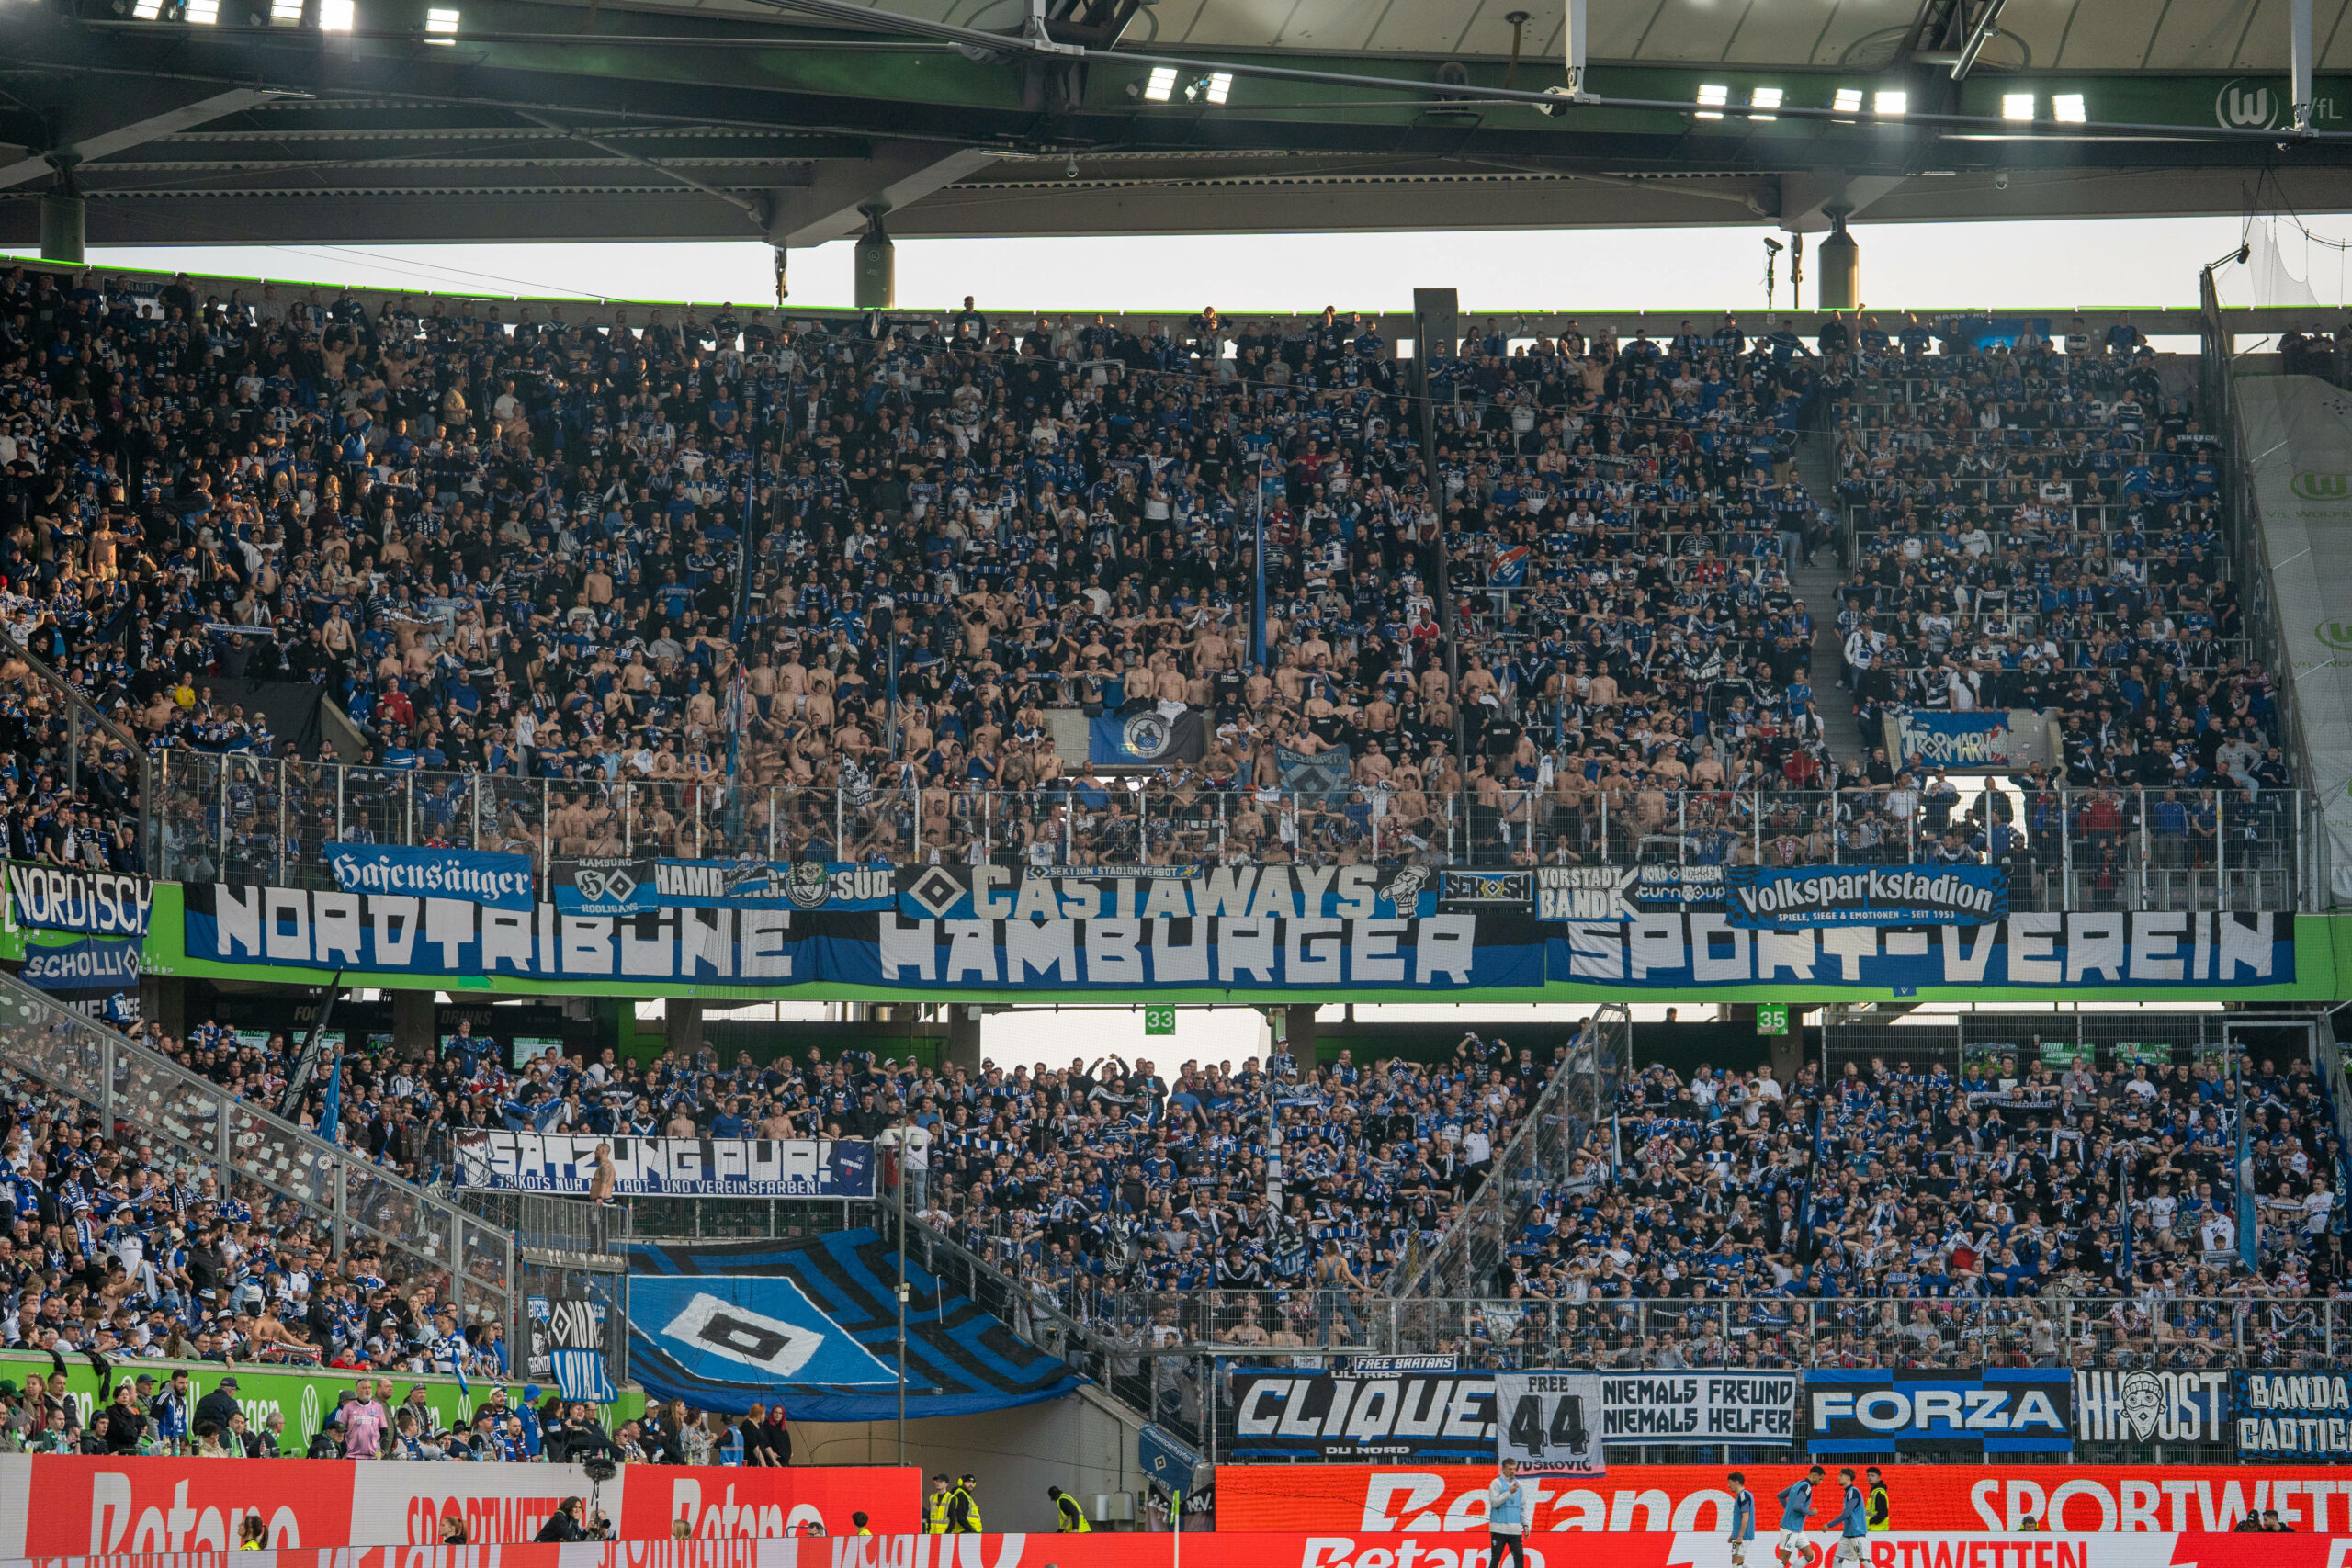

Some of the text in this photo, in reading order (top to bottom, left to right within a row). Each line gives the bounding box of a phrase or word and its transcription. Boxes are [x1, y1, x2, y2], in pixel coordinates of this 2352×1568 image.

[578, 857, 633, 868] HAMBURG
[1050, 866, 1178, 878] SEKTION STADIONVERBOT
[1537, 866, 1623, 889] VORSTADT
[972, 864, 1379, 919] CASTAWAYS
[1703, 886, 1726, 901] up
[1738, 868, 1994, 914] Volksparkstadion
[581, 902, 639, 914] HOOLIGANS
[1539, 887, 1625, 919] BANDE
[1778, 912, 1810, 922] SPIELE,
[1813, 912, 1837, 921] SIEGE
[1840, 912, 1846, 920] &
[1849, 910, 1899, 920] EMOTIONEN
[1911, 909, 1930, 919] SEIT
[1933, 909, 1955, 919] 1953
[879, 911, 1476, 984] HAMBURGER
[25, 950, 123, 977] SCHOLLI
[1148, 1011, 1173, 1027] 33
[1759, 1011, 1786, 1027] 35
[713, 1139, 831, 1183] PUR!
[500, 1175, 551, 1190] TRIKOTS
[555, 1176, 583, 1191] NUR
[613, 1179, 657, 1192] TADT-
[661, 1179, 691, 1193] UND
[695, 1180, 822, 1195] VEREINSFARBEN!
[1357, 1357, 1453, 1371] FREE BRATANS
[1528, 1375, 1569, 1393] FREE
[1602, 1379, 1792, 1405] NIEMALS FREUND
[2249, 1375, 2349, 1410] BANDA
[1602, 1407, 1791, 1435] NIEMALS HELFER
[1811, 1390, 2064, 1431] FORZA
[1509, 1394, 1590, 1458] 44
[1326, 1446, 1410, 1455] DU NORD
